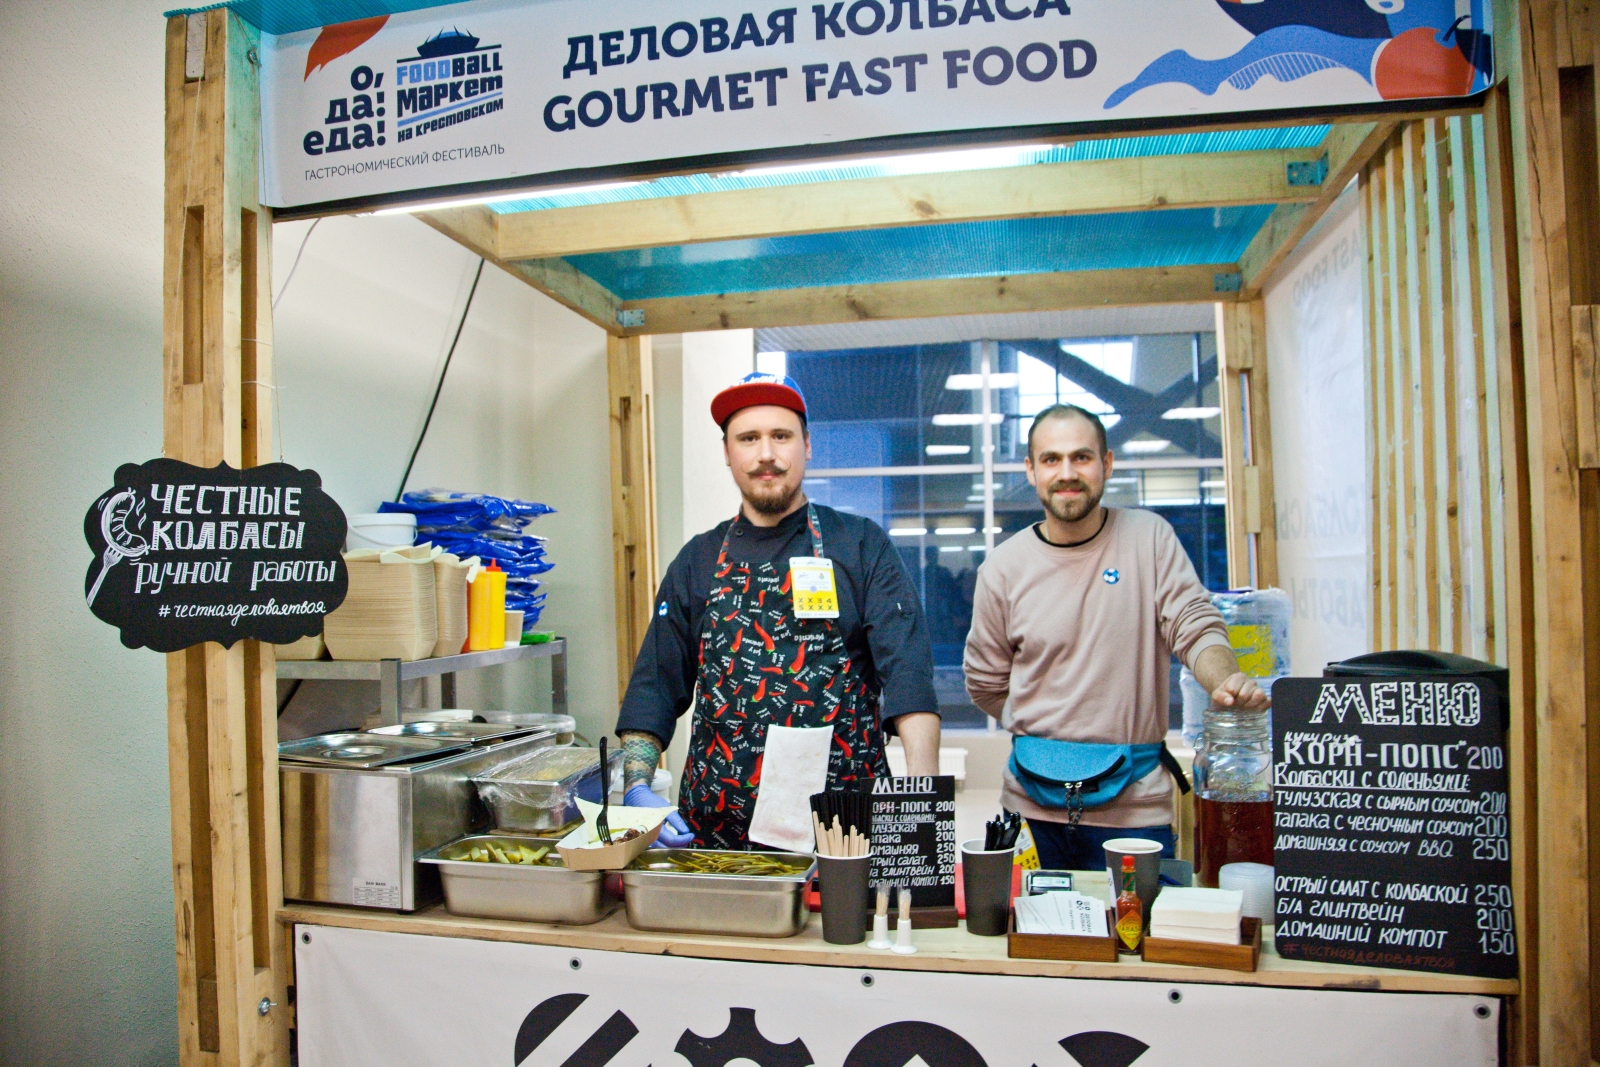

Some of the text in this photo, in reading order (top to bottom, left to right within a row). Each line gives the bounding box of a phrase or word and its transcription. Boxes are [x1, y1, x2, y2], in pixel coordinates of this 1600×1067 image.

[562, 8, 798, 79] ДЕЛОВАЯ
[542, 39, 1098, 132] GOURMET FAST FOOD
[325, 92, 385, 125] да!
[303, 120, 386, 156] еда!
[305, 143, 505, 181] ГАСТРОНОМИЧЕСКИЙ ФЕСТИВАЛЬ
[151, 484, 302, 516] ЧЕСТНЫЕ
[150, 520, 306, 551] КОЛБАСЫ
[1308, 681, 1481, 726] МЕНЮ
[1466, 745, 1503, 770] 200
[871, 776, 934, 794] МЕНЮ
[872, 800, 955, 814] ОРН-ПОПС 200
[1480, 791, 1507, 815] 200
[935, 820, 955, 831] 200
[935, 831, 955, 842] 200
[1474, 815, 1508, 838] 200
[936, 842, 955, 853] 250
[937, 853, 955, 864] 250
[1417, 839, 1454, 858] BBQ
[1472, 838, 1509, 861] 250
[939, 864, 955, 874] 200
[1474, 884, 1512, 908] 250
[1476, 907, 1513, 932] 200
[1276, 920, 1515, 956] ДОМАШНИЙ КОМПОТ 150
